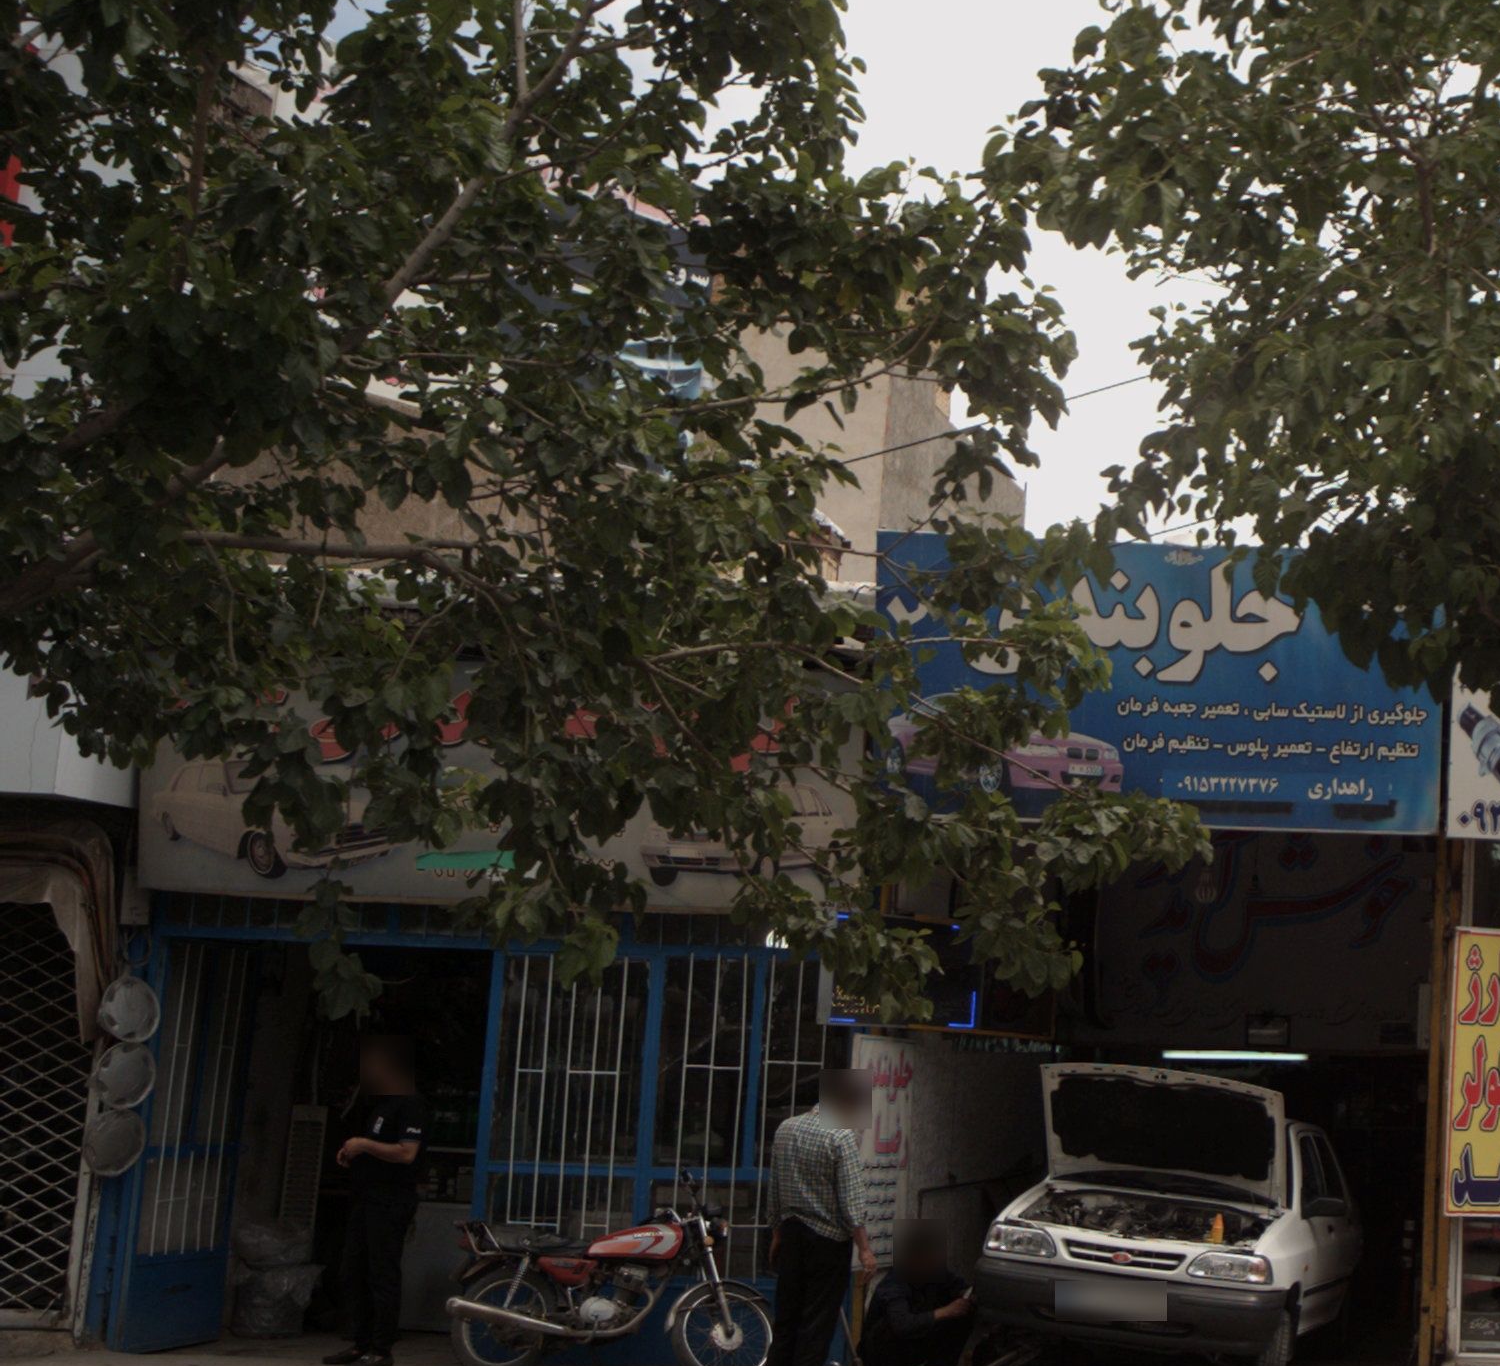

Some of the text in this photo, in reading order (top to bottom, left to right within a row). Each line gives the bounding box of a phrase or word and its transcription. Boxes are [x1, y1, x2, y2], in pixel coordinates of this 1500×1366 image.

[1116, 695, 1160, 717] فرمان
[1162, 700, 1198, 720] جعبه
[1199, 698, 1241, 720] تعمیر
[1252, 700, 1290, 722] سابی
[1292, 700, 1346, 721] لاستیک
[1349, 703, 1364, 725] از
[1367, 703, 1428, 727] جلوگیری
[1122, 731, 1166, 754] فرمان
[1167, 733, 1210, 756] تنظیم
[1226, 736, 1270, 760] پلوس
[1272, 737, 1314, 759] تعمیر
[1327, 739, 1374, 765] ارتفاع
[1376, 739, 1420, 762] تنظیم
[1307, 777, 1374, 802] راهداری
